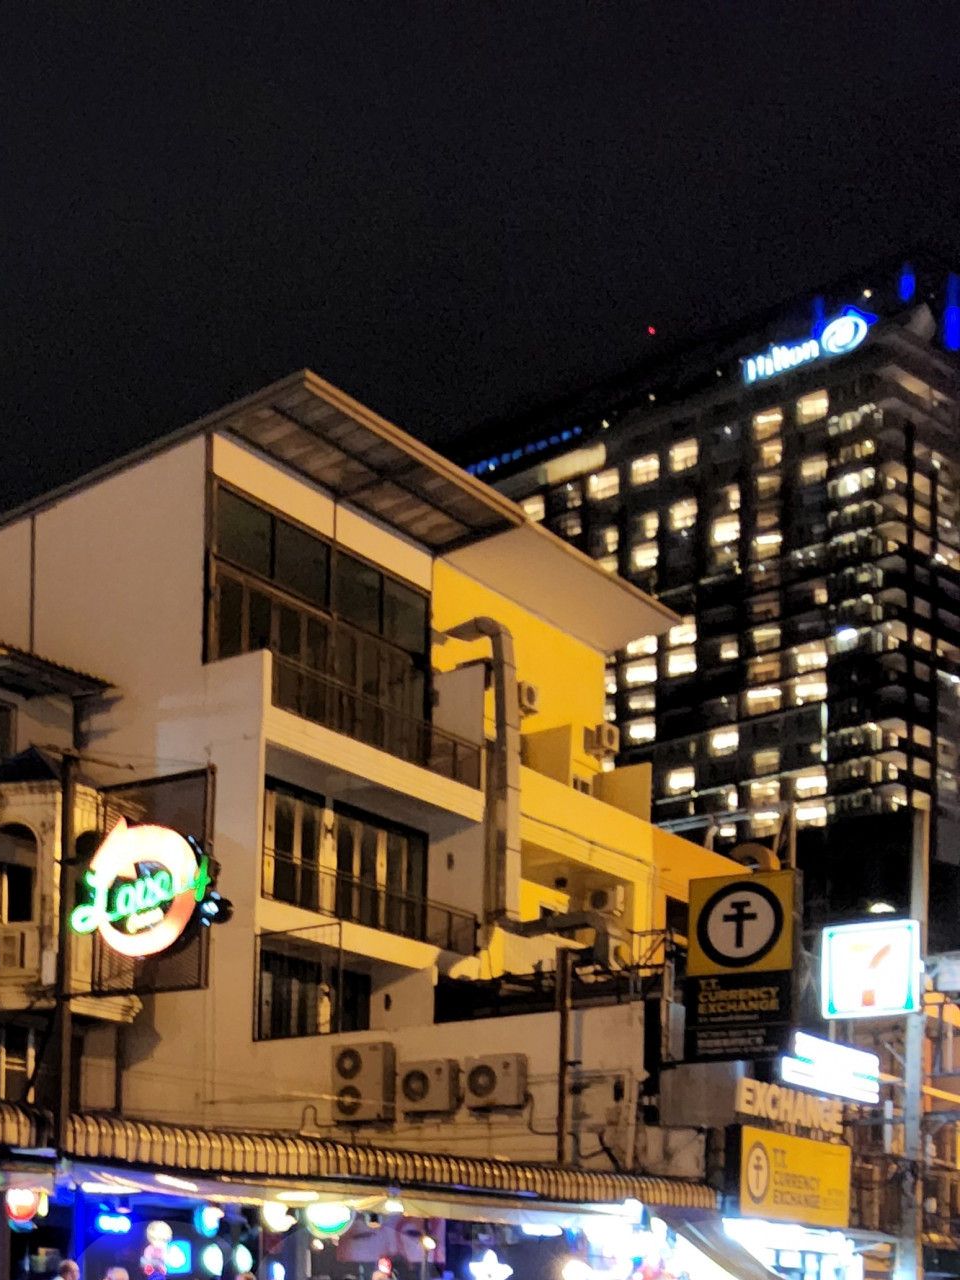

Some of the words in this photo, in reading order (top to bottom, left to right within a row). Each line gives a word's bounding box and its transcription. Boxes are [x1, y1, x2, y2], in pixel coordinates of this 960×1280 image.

[748, 340, 820, 382] Hilton
[699, 986, 780, 1003] CURRENCY
[697, 999, 780, 1014] EXCHANGE
[735, 1077, 844, 1134] EXCHANGE
[773, 1170, 821, 1191] CURRENCY
[773, 1190, 821, 1209] EXCHANGE
